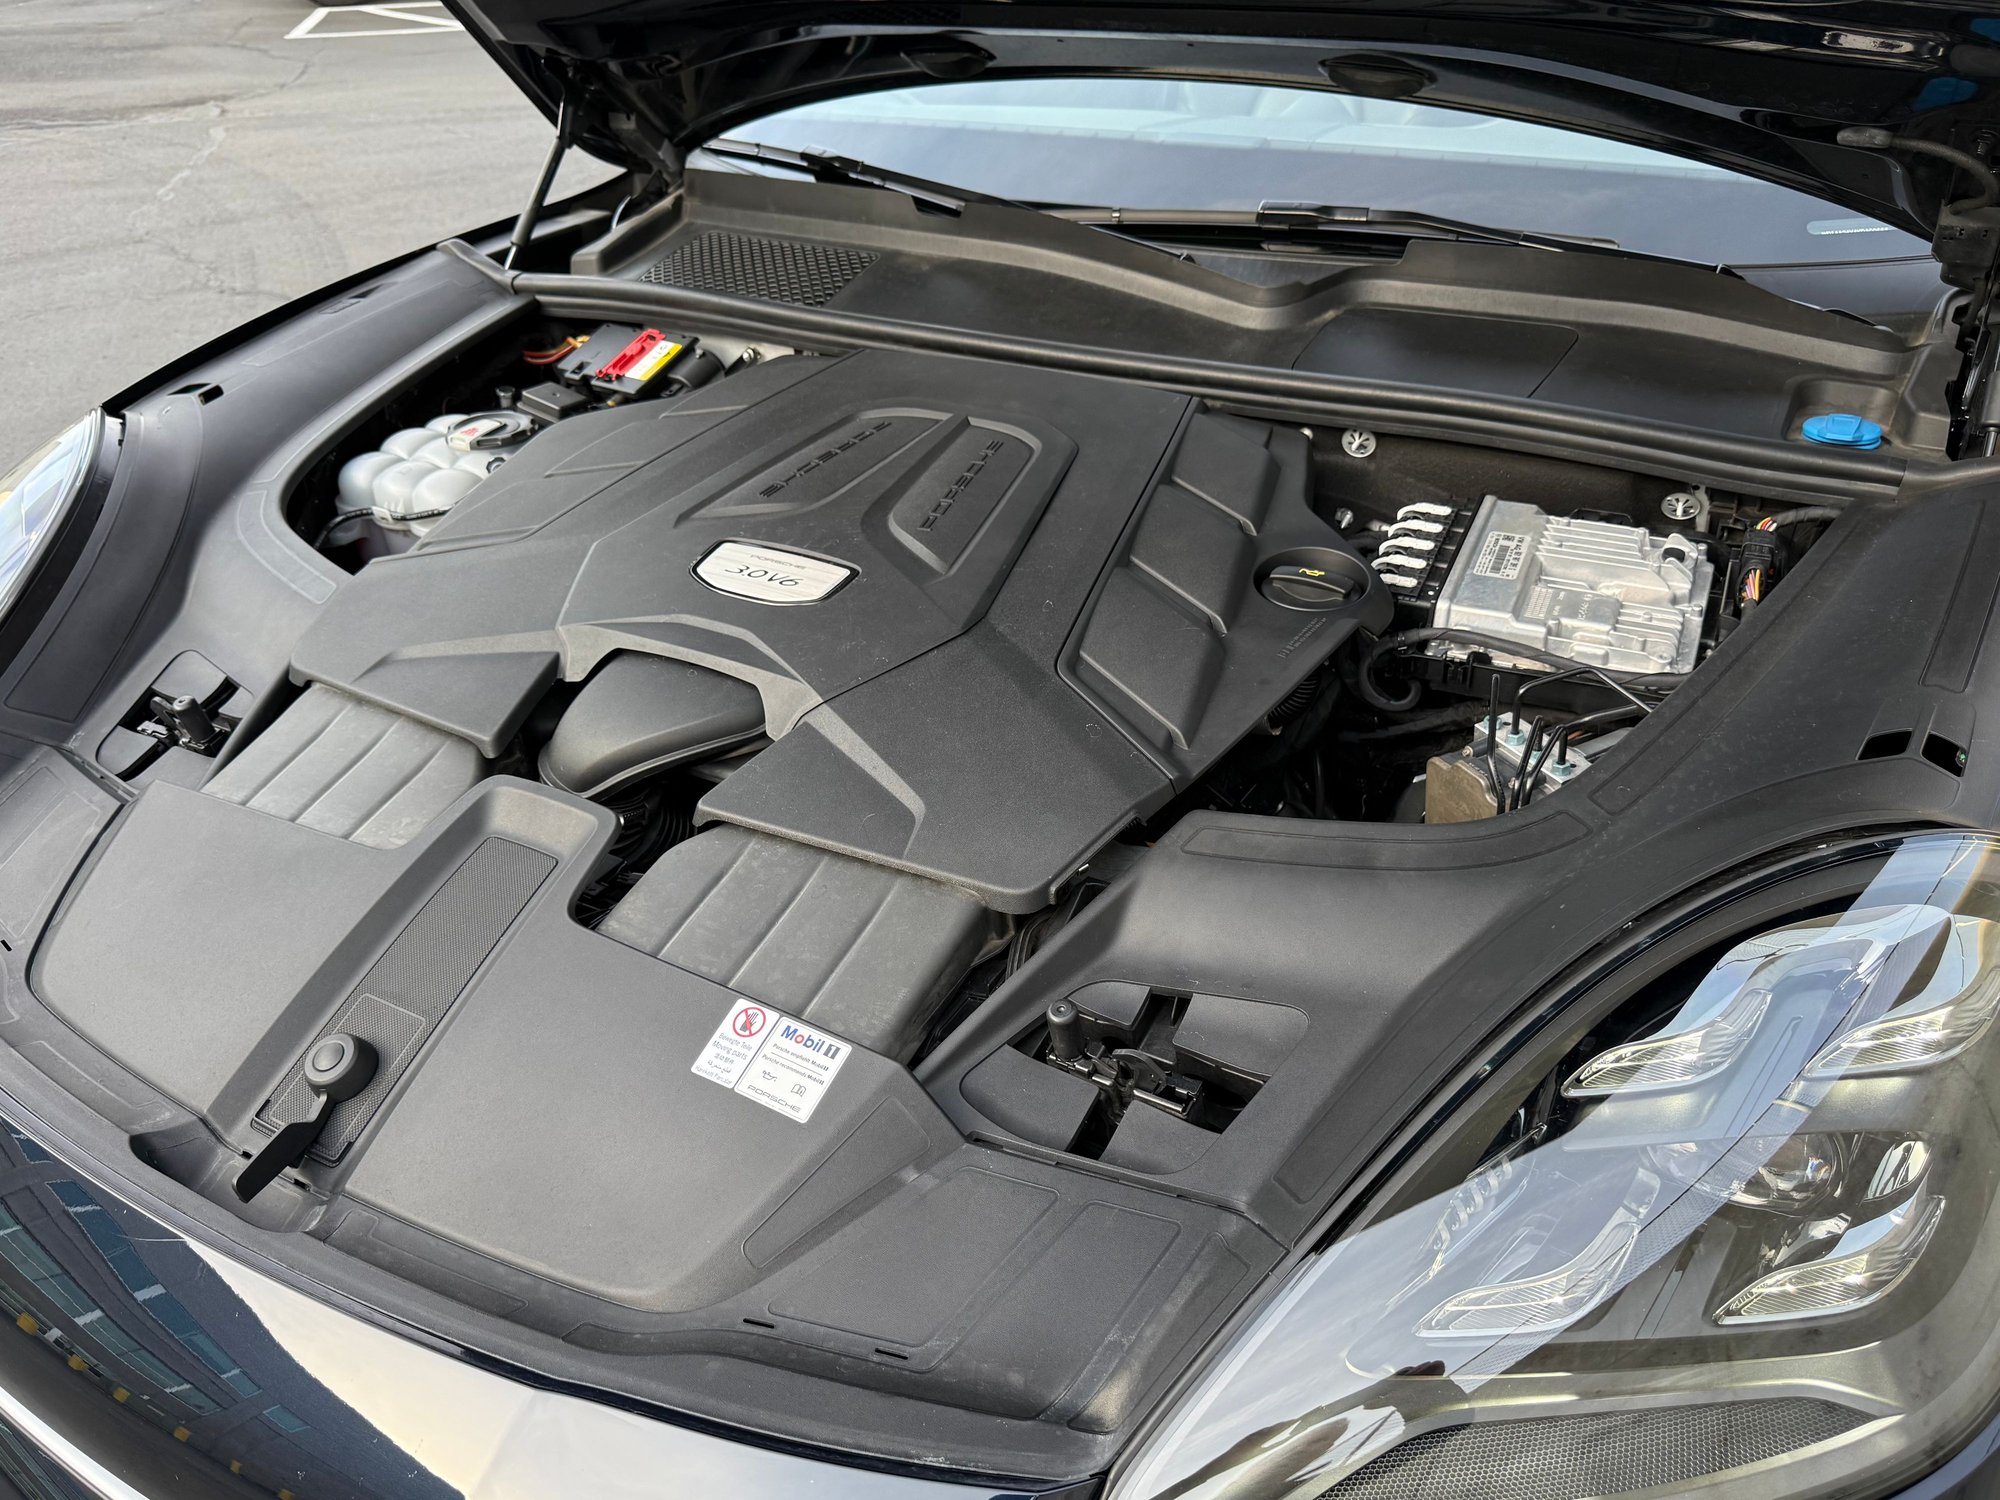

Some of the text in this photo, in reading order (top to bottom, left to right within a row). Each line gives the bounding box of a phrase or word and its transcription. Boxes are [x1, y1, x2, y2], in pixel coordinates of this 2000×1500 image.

[758, 421, 892, 498] PORSCHE
[917, 440, 1004, 532] PORSCHE
[750, 554, 807, 570] PORSCHE
[767, 572, 804, 587] V6
[712, 1040, 748, 1061] Moving parts
[773, 1043, 790, 1054] Porsche
[781, 1025, 841, 1060] Mobil 1
[762, 1053, 780, 1065] Porsche
[779, 1062, 807, 1078] recommends
[747, 1084, 802, 1113] PORSCHE
